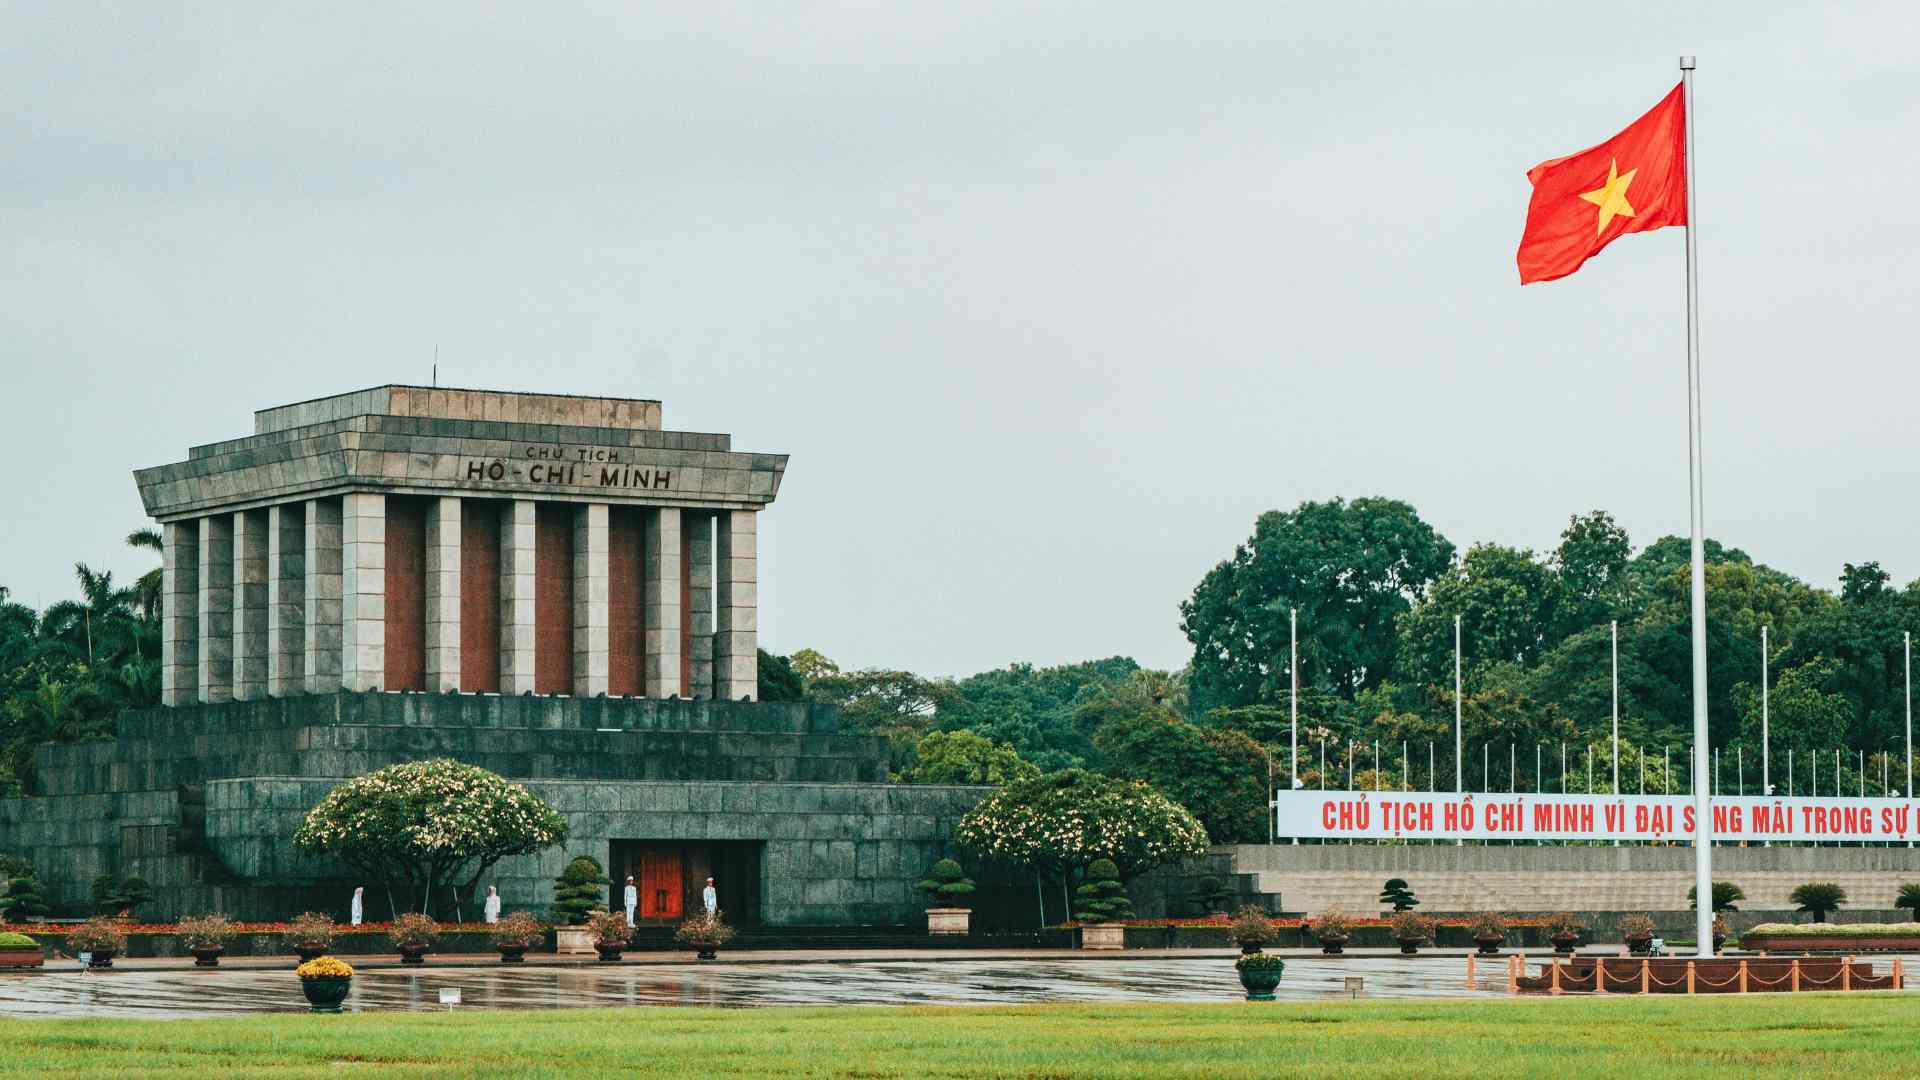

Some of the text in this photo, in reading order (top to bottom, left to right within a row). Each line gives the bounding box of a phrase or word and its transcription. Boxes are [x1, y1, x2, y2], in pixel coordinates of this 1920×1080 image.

[1322, 793, 1370, 831] CHỦ
[1380, 801, 1433, 837] TỊCH
[1444, 794, 1474, 832] HỒ
[1484, 797, 1523, 832] CHÍ
[1534, 803, 1594, 832] MINH
[1635, 804, 1673, 837] ĐẠI
[1683, 805, 1743, 833] SNG
[1752, 801, 1793, 833] MÃI
[1802, 806, 1872, 834] TRONG
[1881, 803, 1910, 839] SỰ
